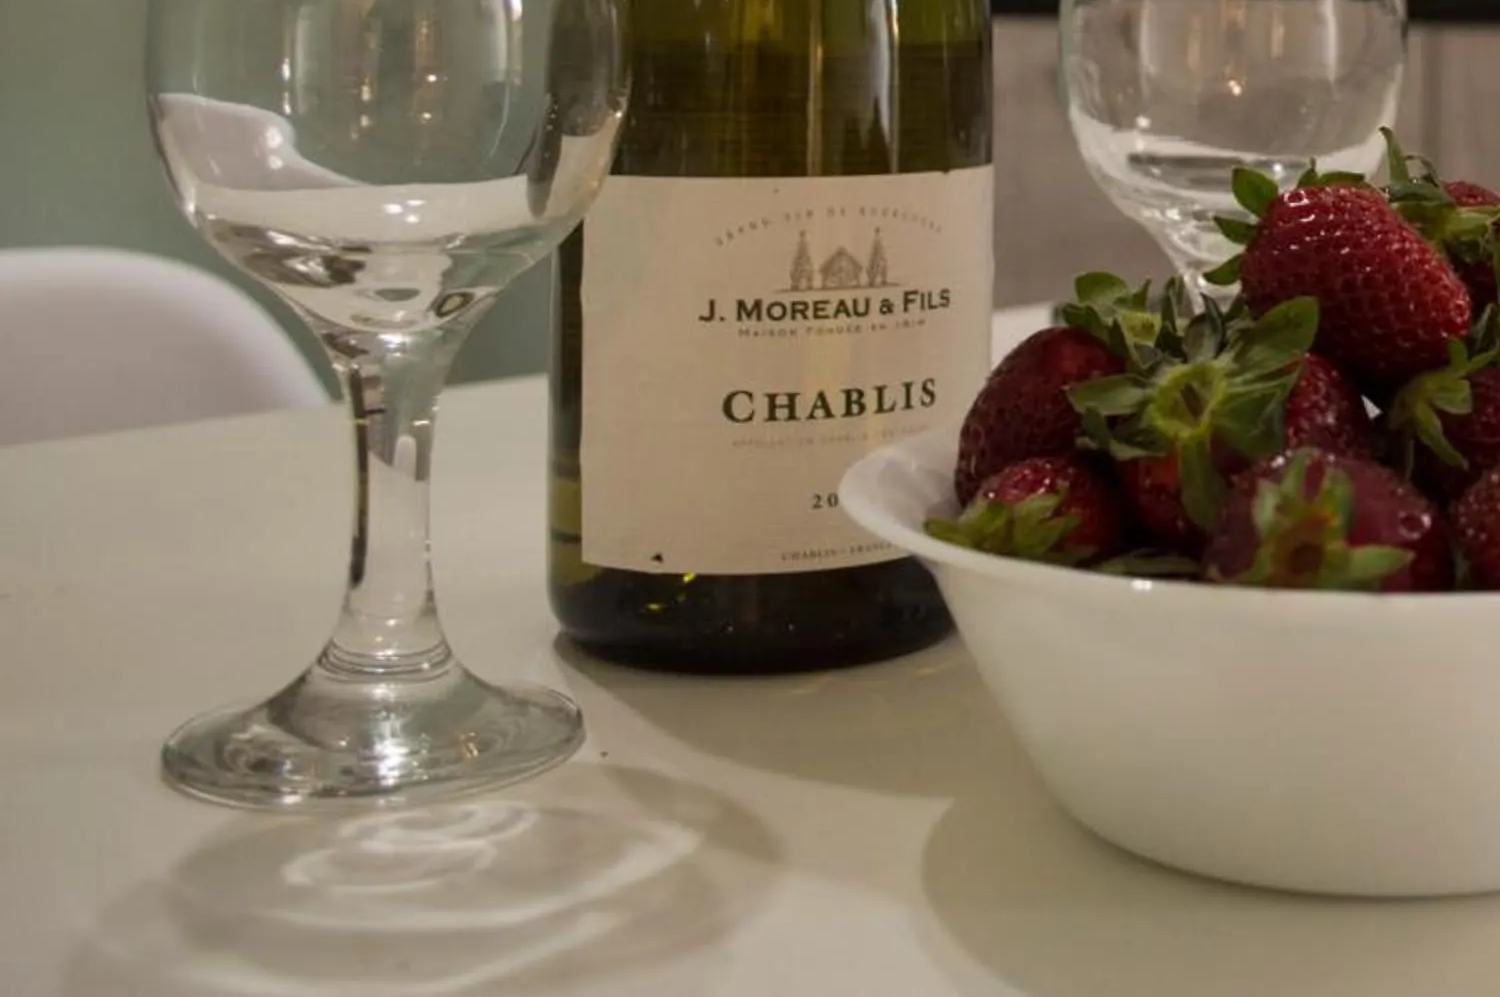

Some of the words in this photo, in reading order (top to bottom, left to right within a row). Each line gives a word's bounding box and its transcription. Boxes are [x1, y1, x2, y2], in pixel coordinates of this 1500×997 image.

[698, 299, 726, 324] J.
[736, 297, 872, 323] MOREAU
[879, 298, 894, 315] &
[902, 288, 952, 314] FILS
[721, 377, 937, 424] CHABLIS
[811, 492, 839, 510] 20
